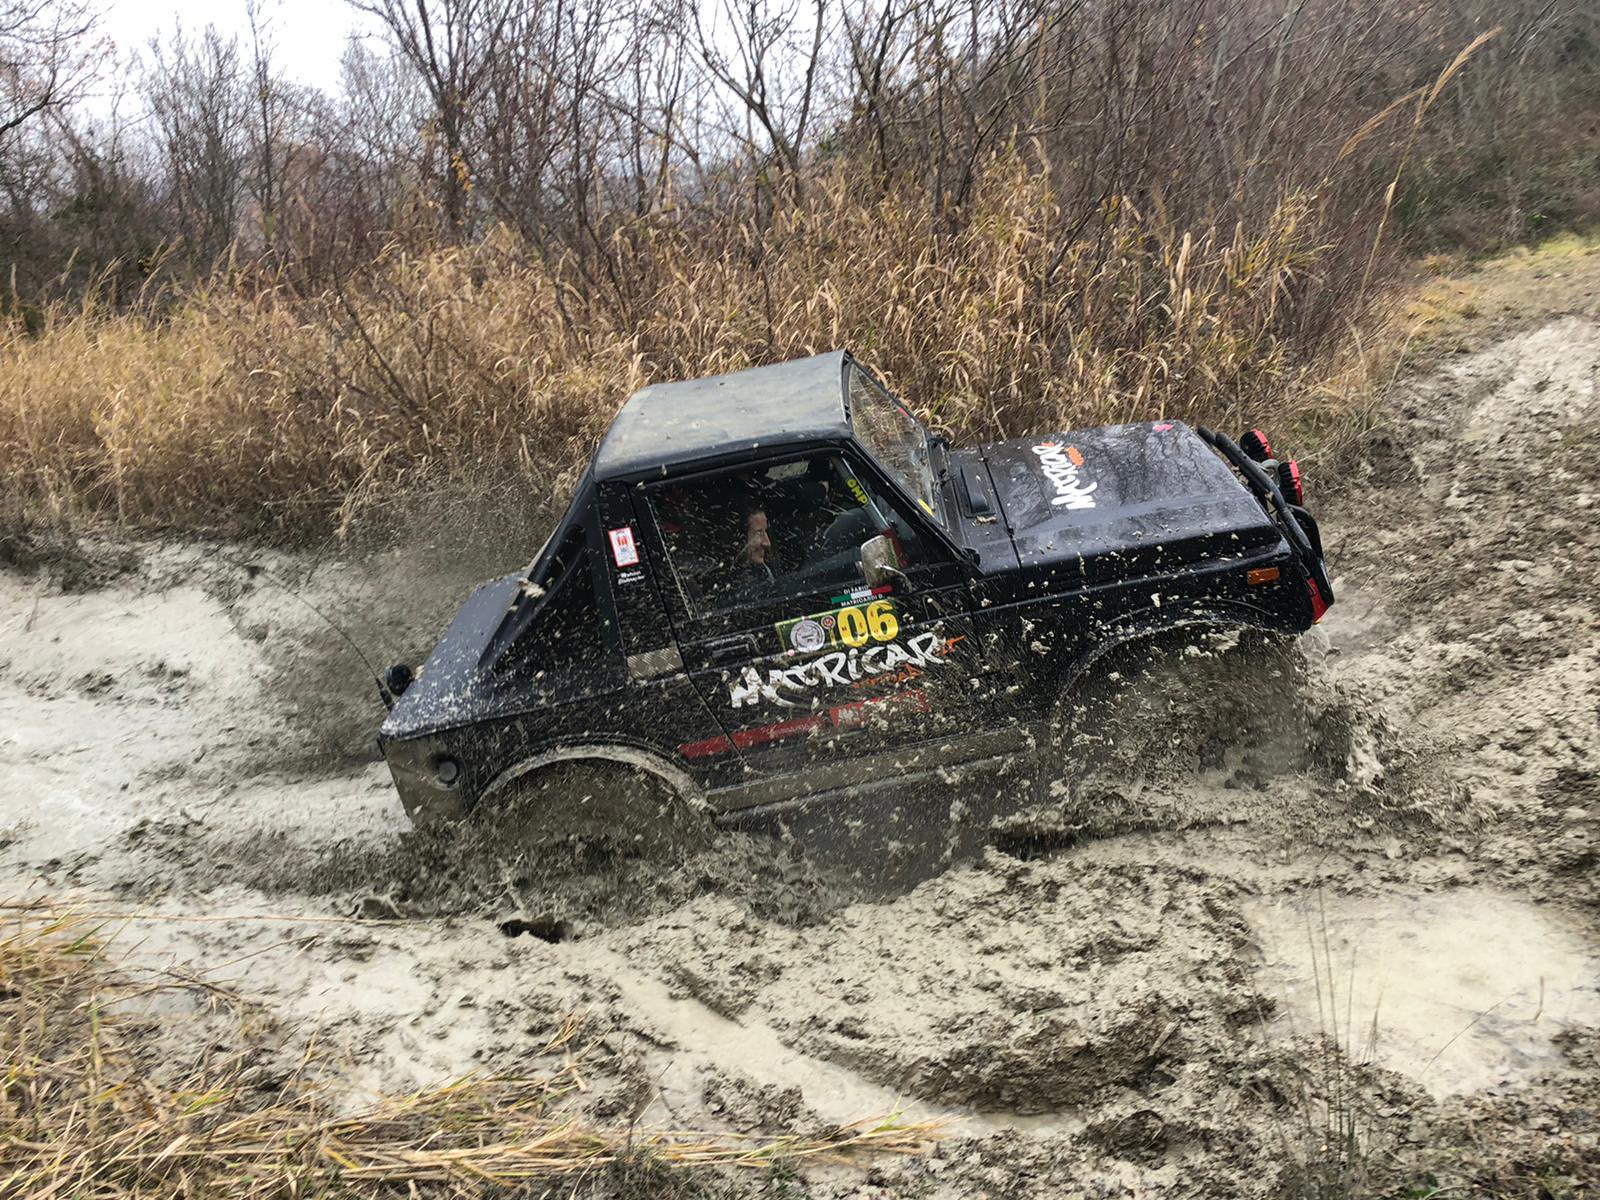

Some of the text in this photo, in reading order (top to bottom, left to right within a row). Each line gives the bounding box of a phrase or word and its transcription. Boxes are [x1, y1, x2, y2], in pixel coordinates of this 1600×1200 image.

[847, 479, 868, 506] OMP
[841, 596, 877, 606] MATRICARDI
[839, 602, 898, 645] 06
